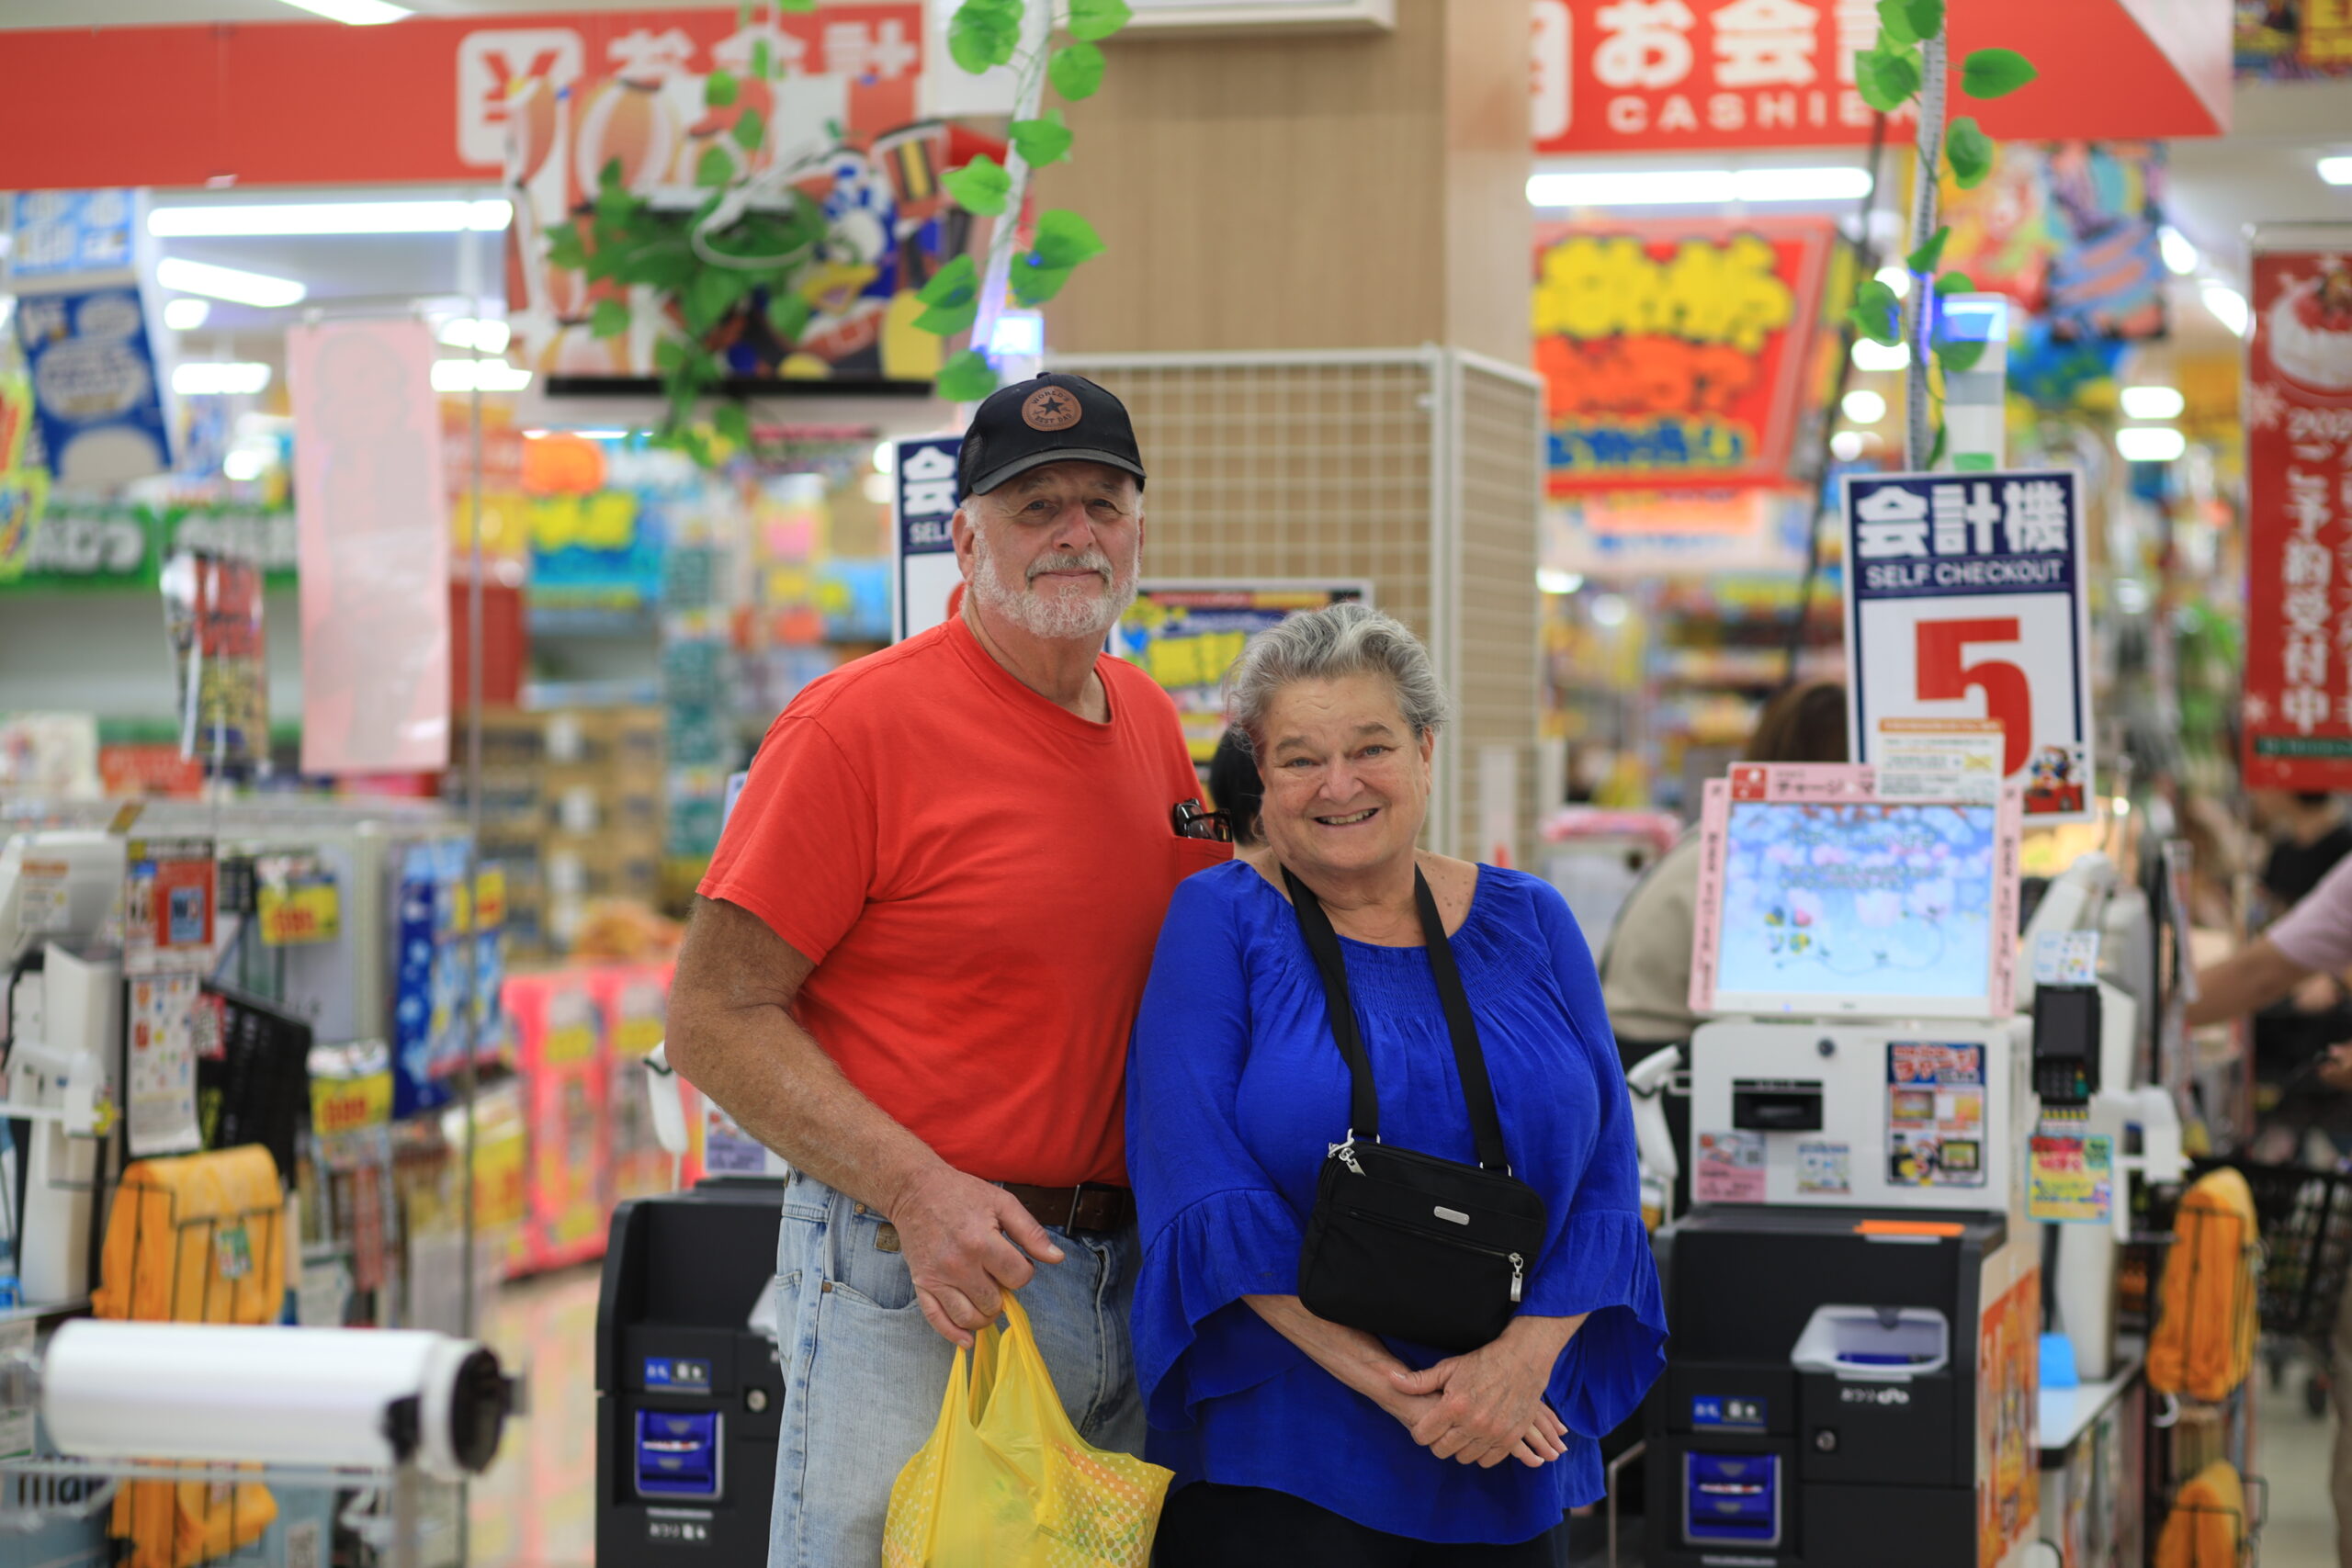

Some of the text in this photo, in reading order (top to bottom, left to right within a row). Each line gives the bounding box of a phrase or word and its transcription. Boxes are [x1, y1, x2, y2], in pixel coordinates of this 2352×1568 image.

[1856, 480, 2068, 558] 会計機
[1866, 558, 2063, 590] SELF CHECKOUT
[1916, 616, 2032, 774] 5
